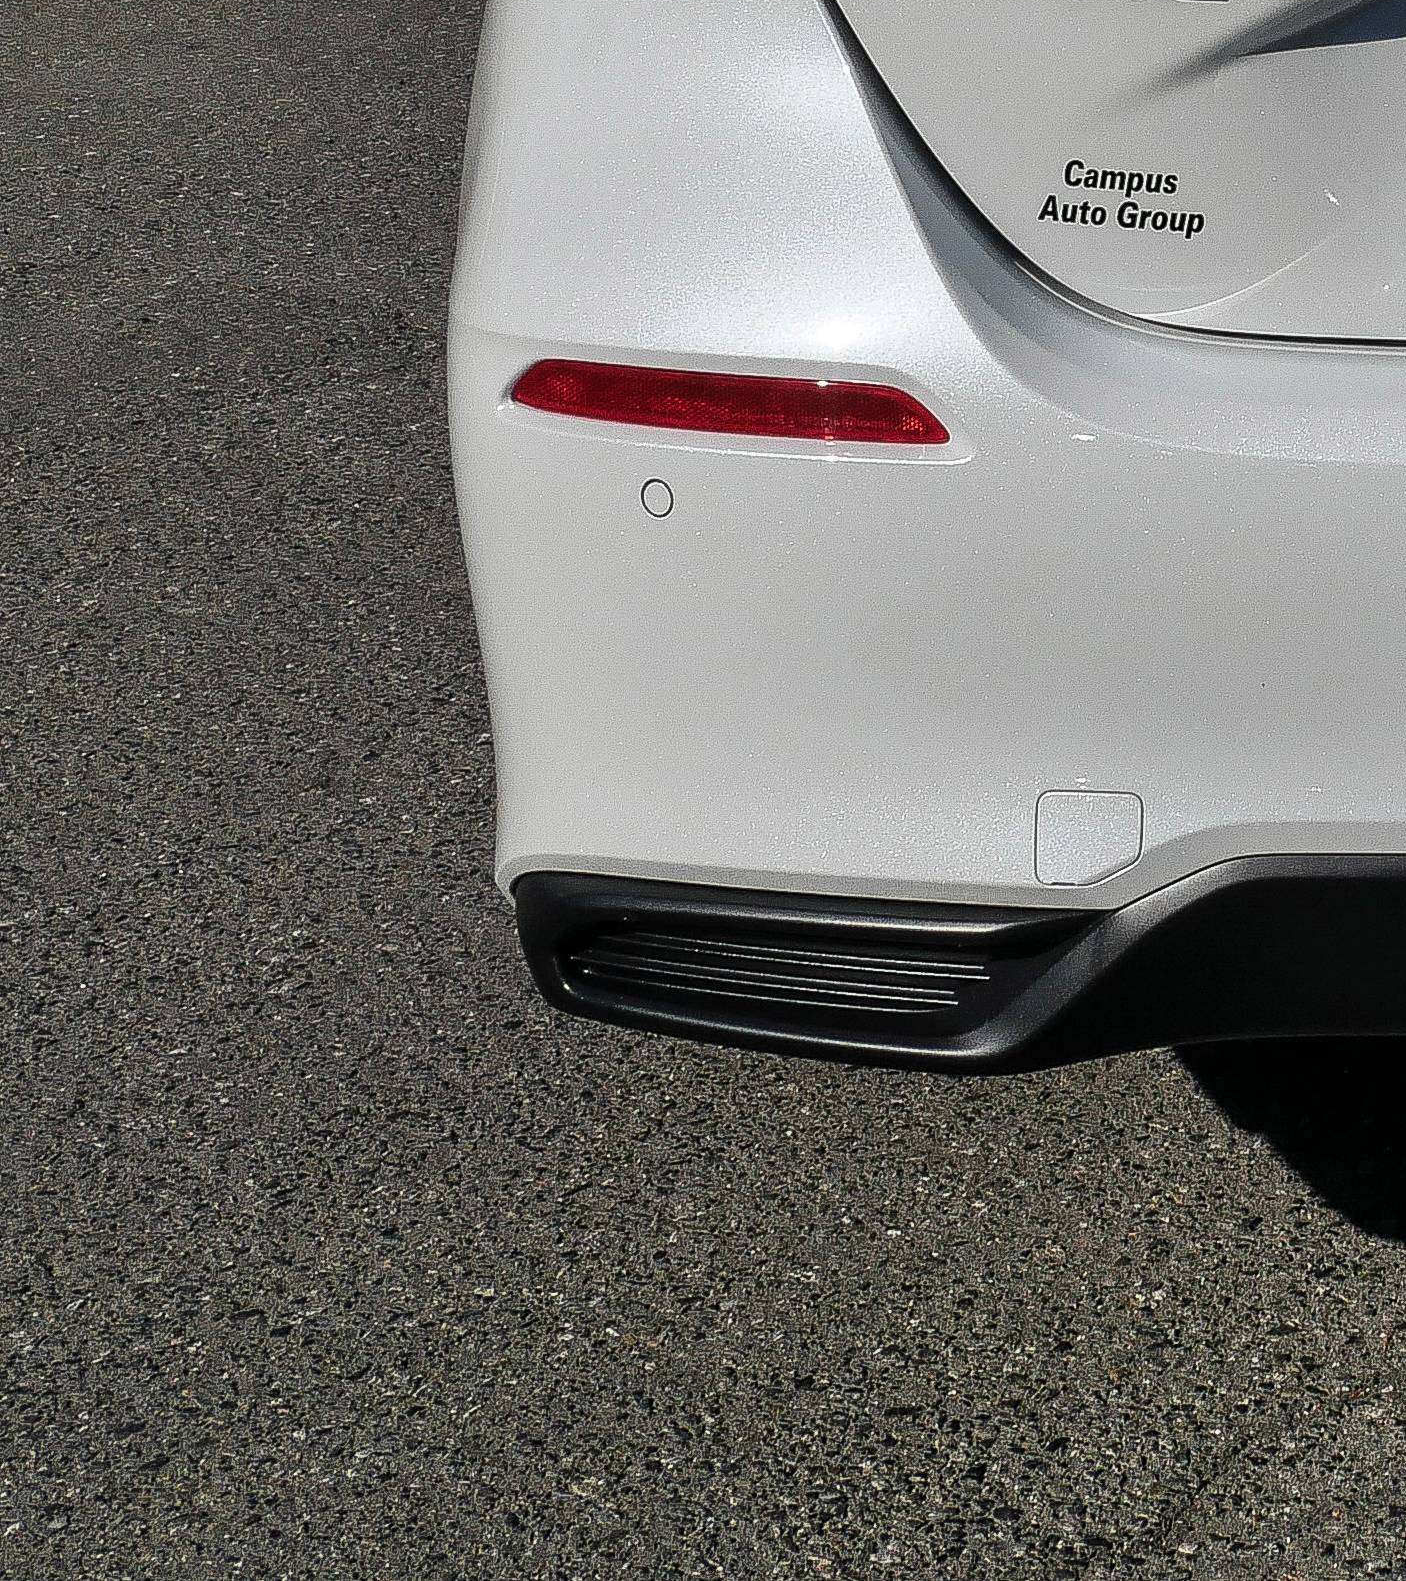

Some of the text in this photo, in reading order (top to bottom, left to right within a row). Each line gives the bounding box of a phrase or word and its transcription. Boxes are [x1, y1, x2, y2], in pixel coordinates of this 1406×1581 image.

[1063, 159, 1179, 199] Campus
[1037, 194, 1206, 239] Auto Group
